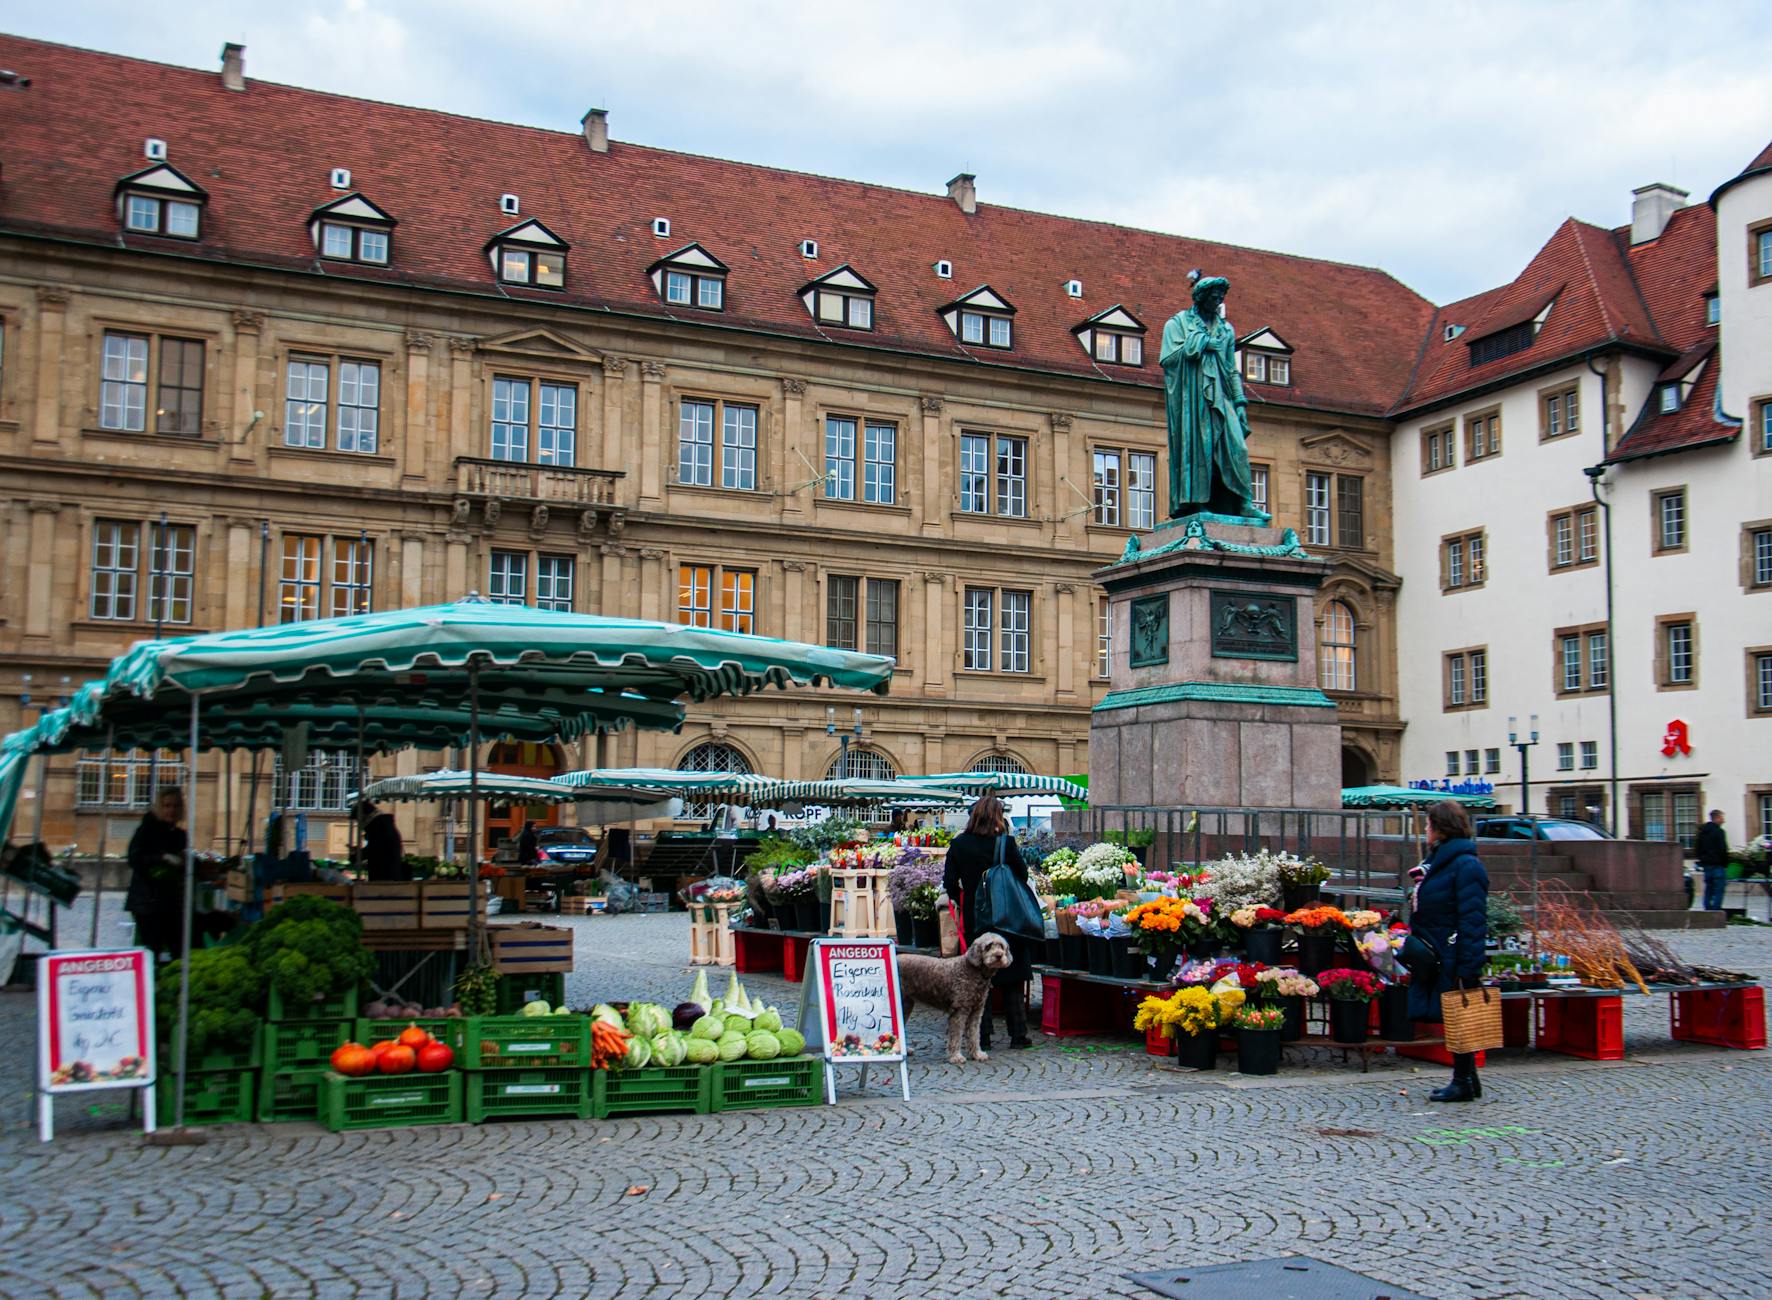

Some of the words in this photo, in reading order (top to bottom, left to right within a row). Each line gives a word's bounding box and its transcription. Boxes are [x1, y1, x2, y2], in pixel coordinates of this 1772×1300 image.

[829, 947, 883, 958] ANGEBOT
[58, 957, 134, 973] ANGEBOT
[834, 962, 880, 984] Eigener
[834, 983, 883, 998] Rosenkohl
[839, 1006, 858, 1030] 1kg
